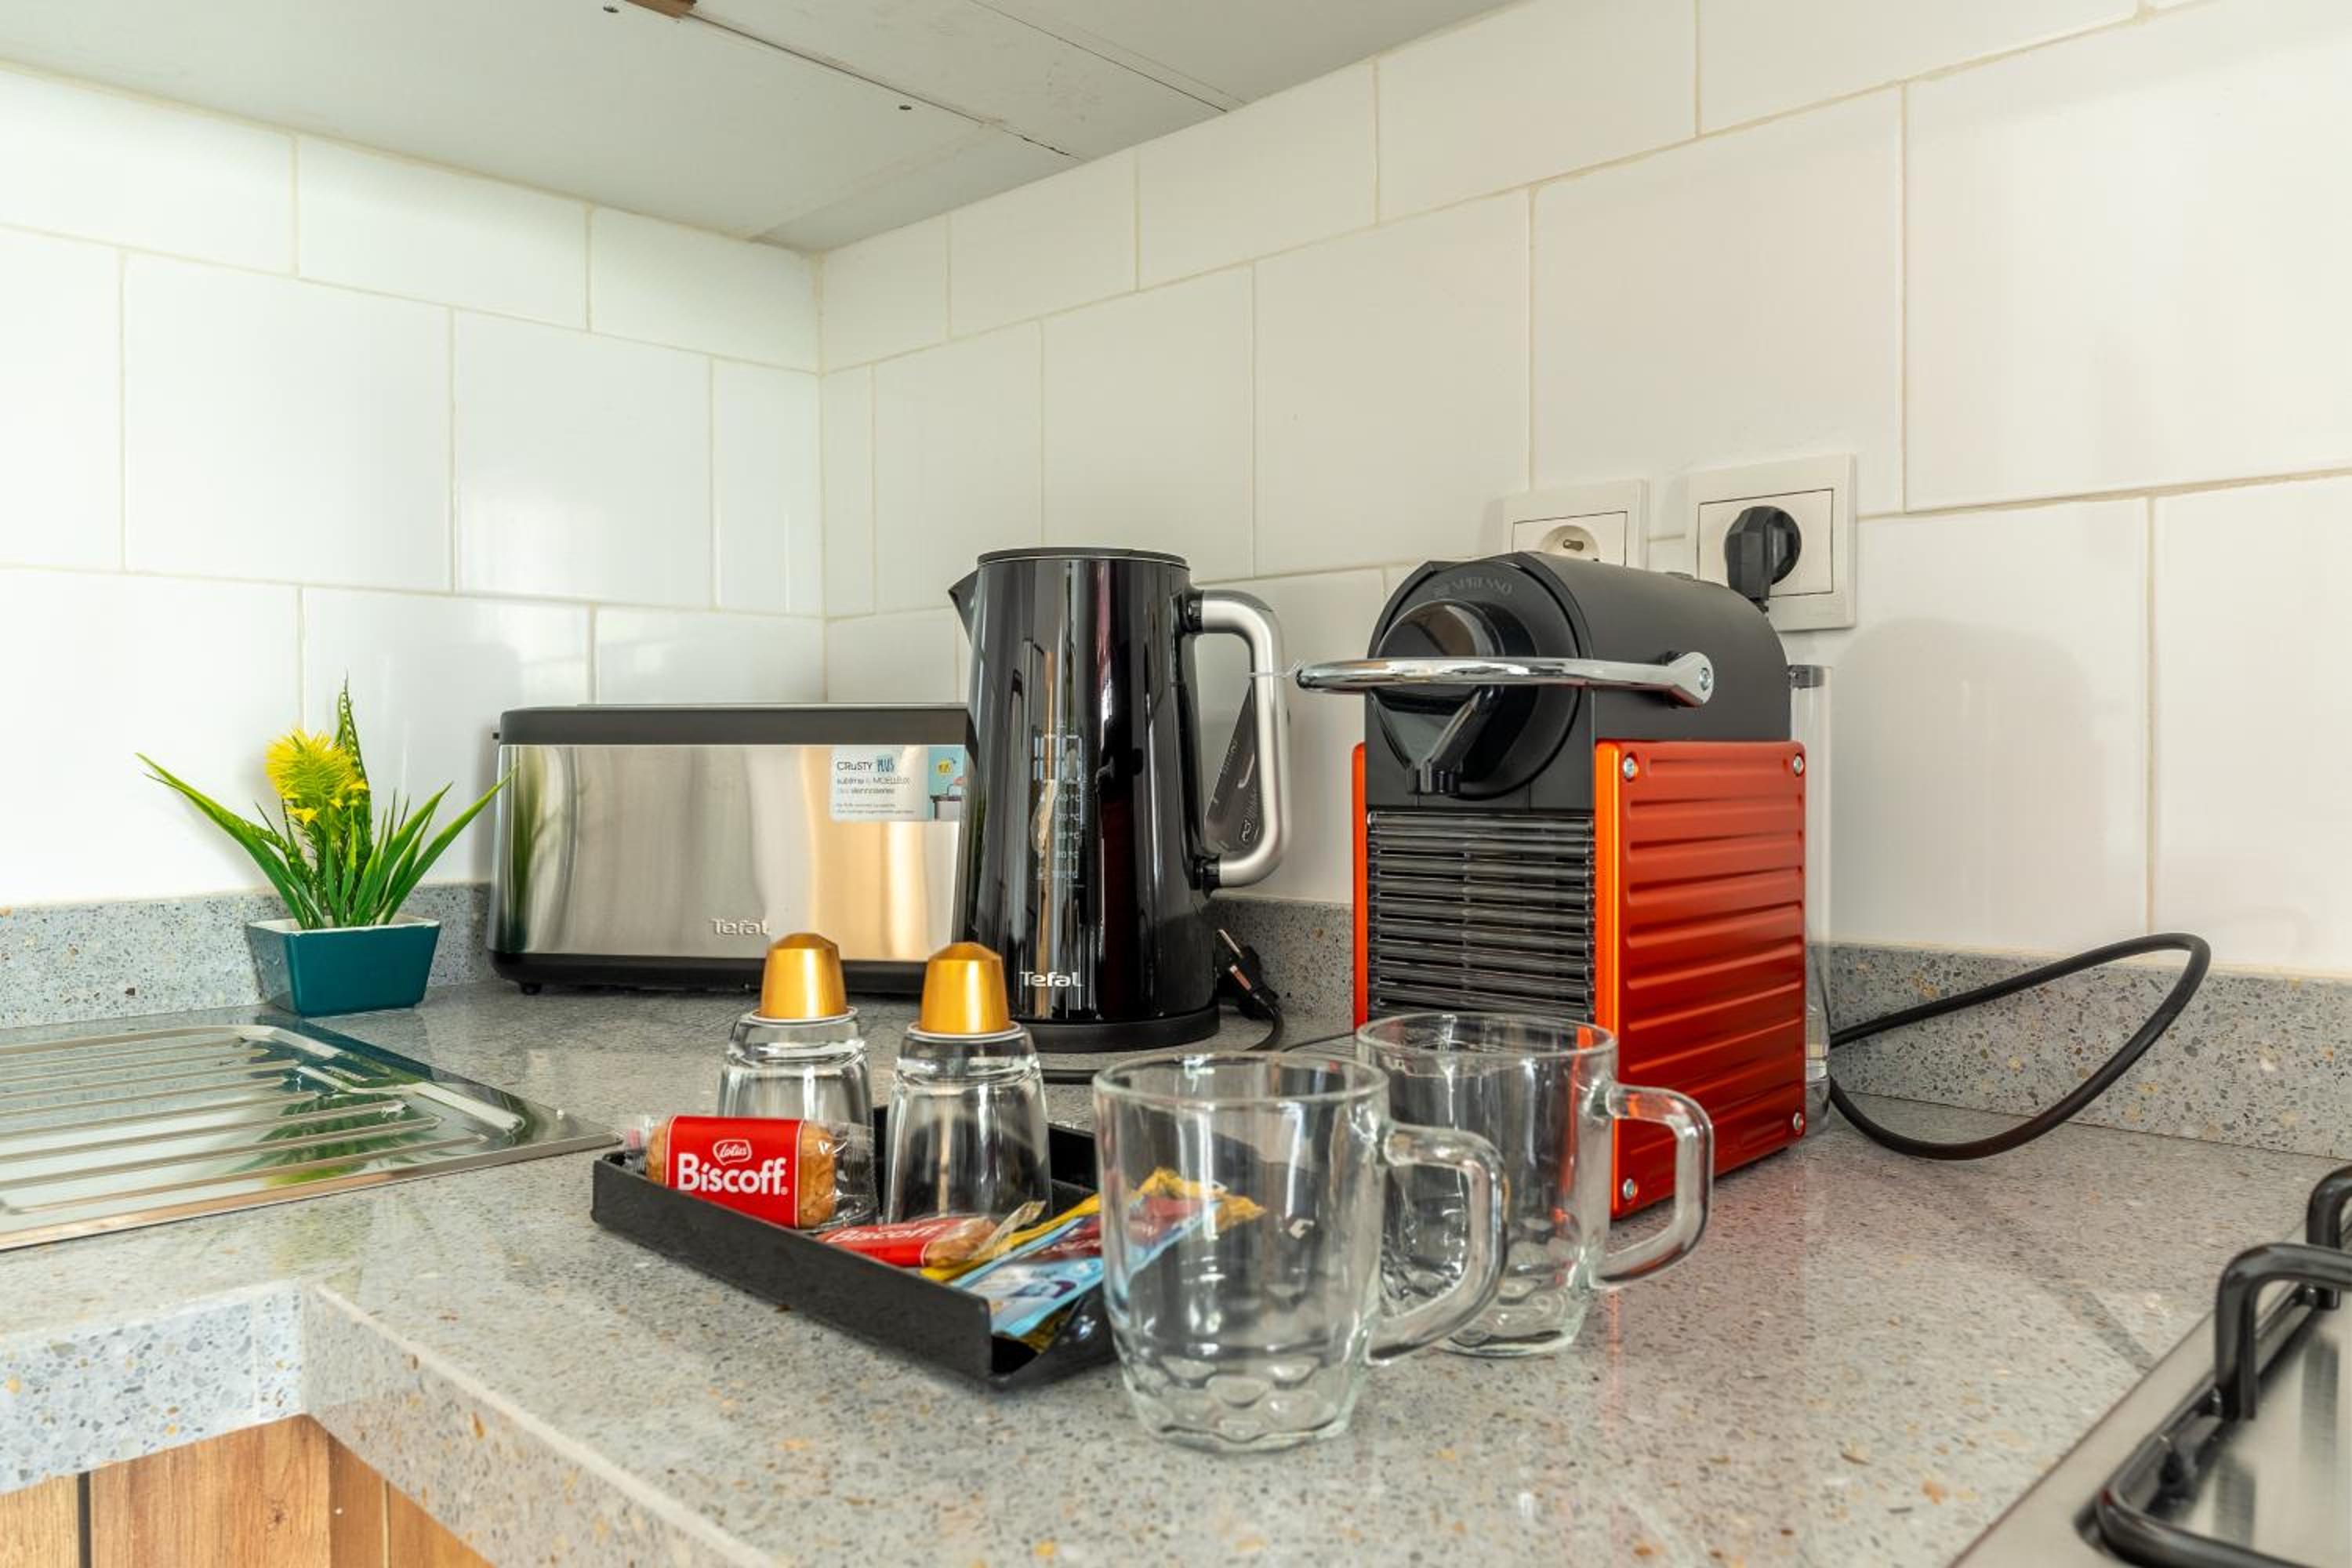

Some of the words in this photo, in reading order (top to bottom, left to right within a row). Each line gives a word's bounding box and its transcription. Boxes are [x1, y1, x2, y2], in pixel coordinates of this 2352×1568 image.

[877, 757, 895, 772] PLUS
[712, 918, 771, 935] Tefal
[1019, 971, 1085, 987] Tefal
[718, 1142, 749, 1158] Lotus
